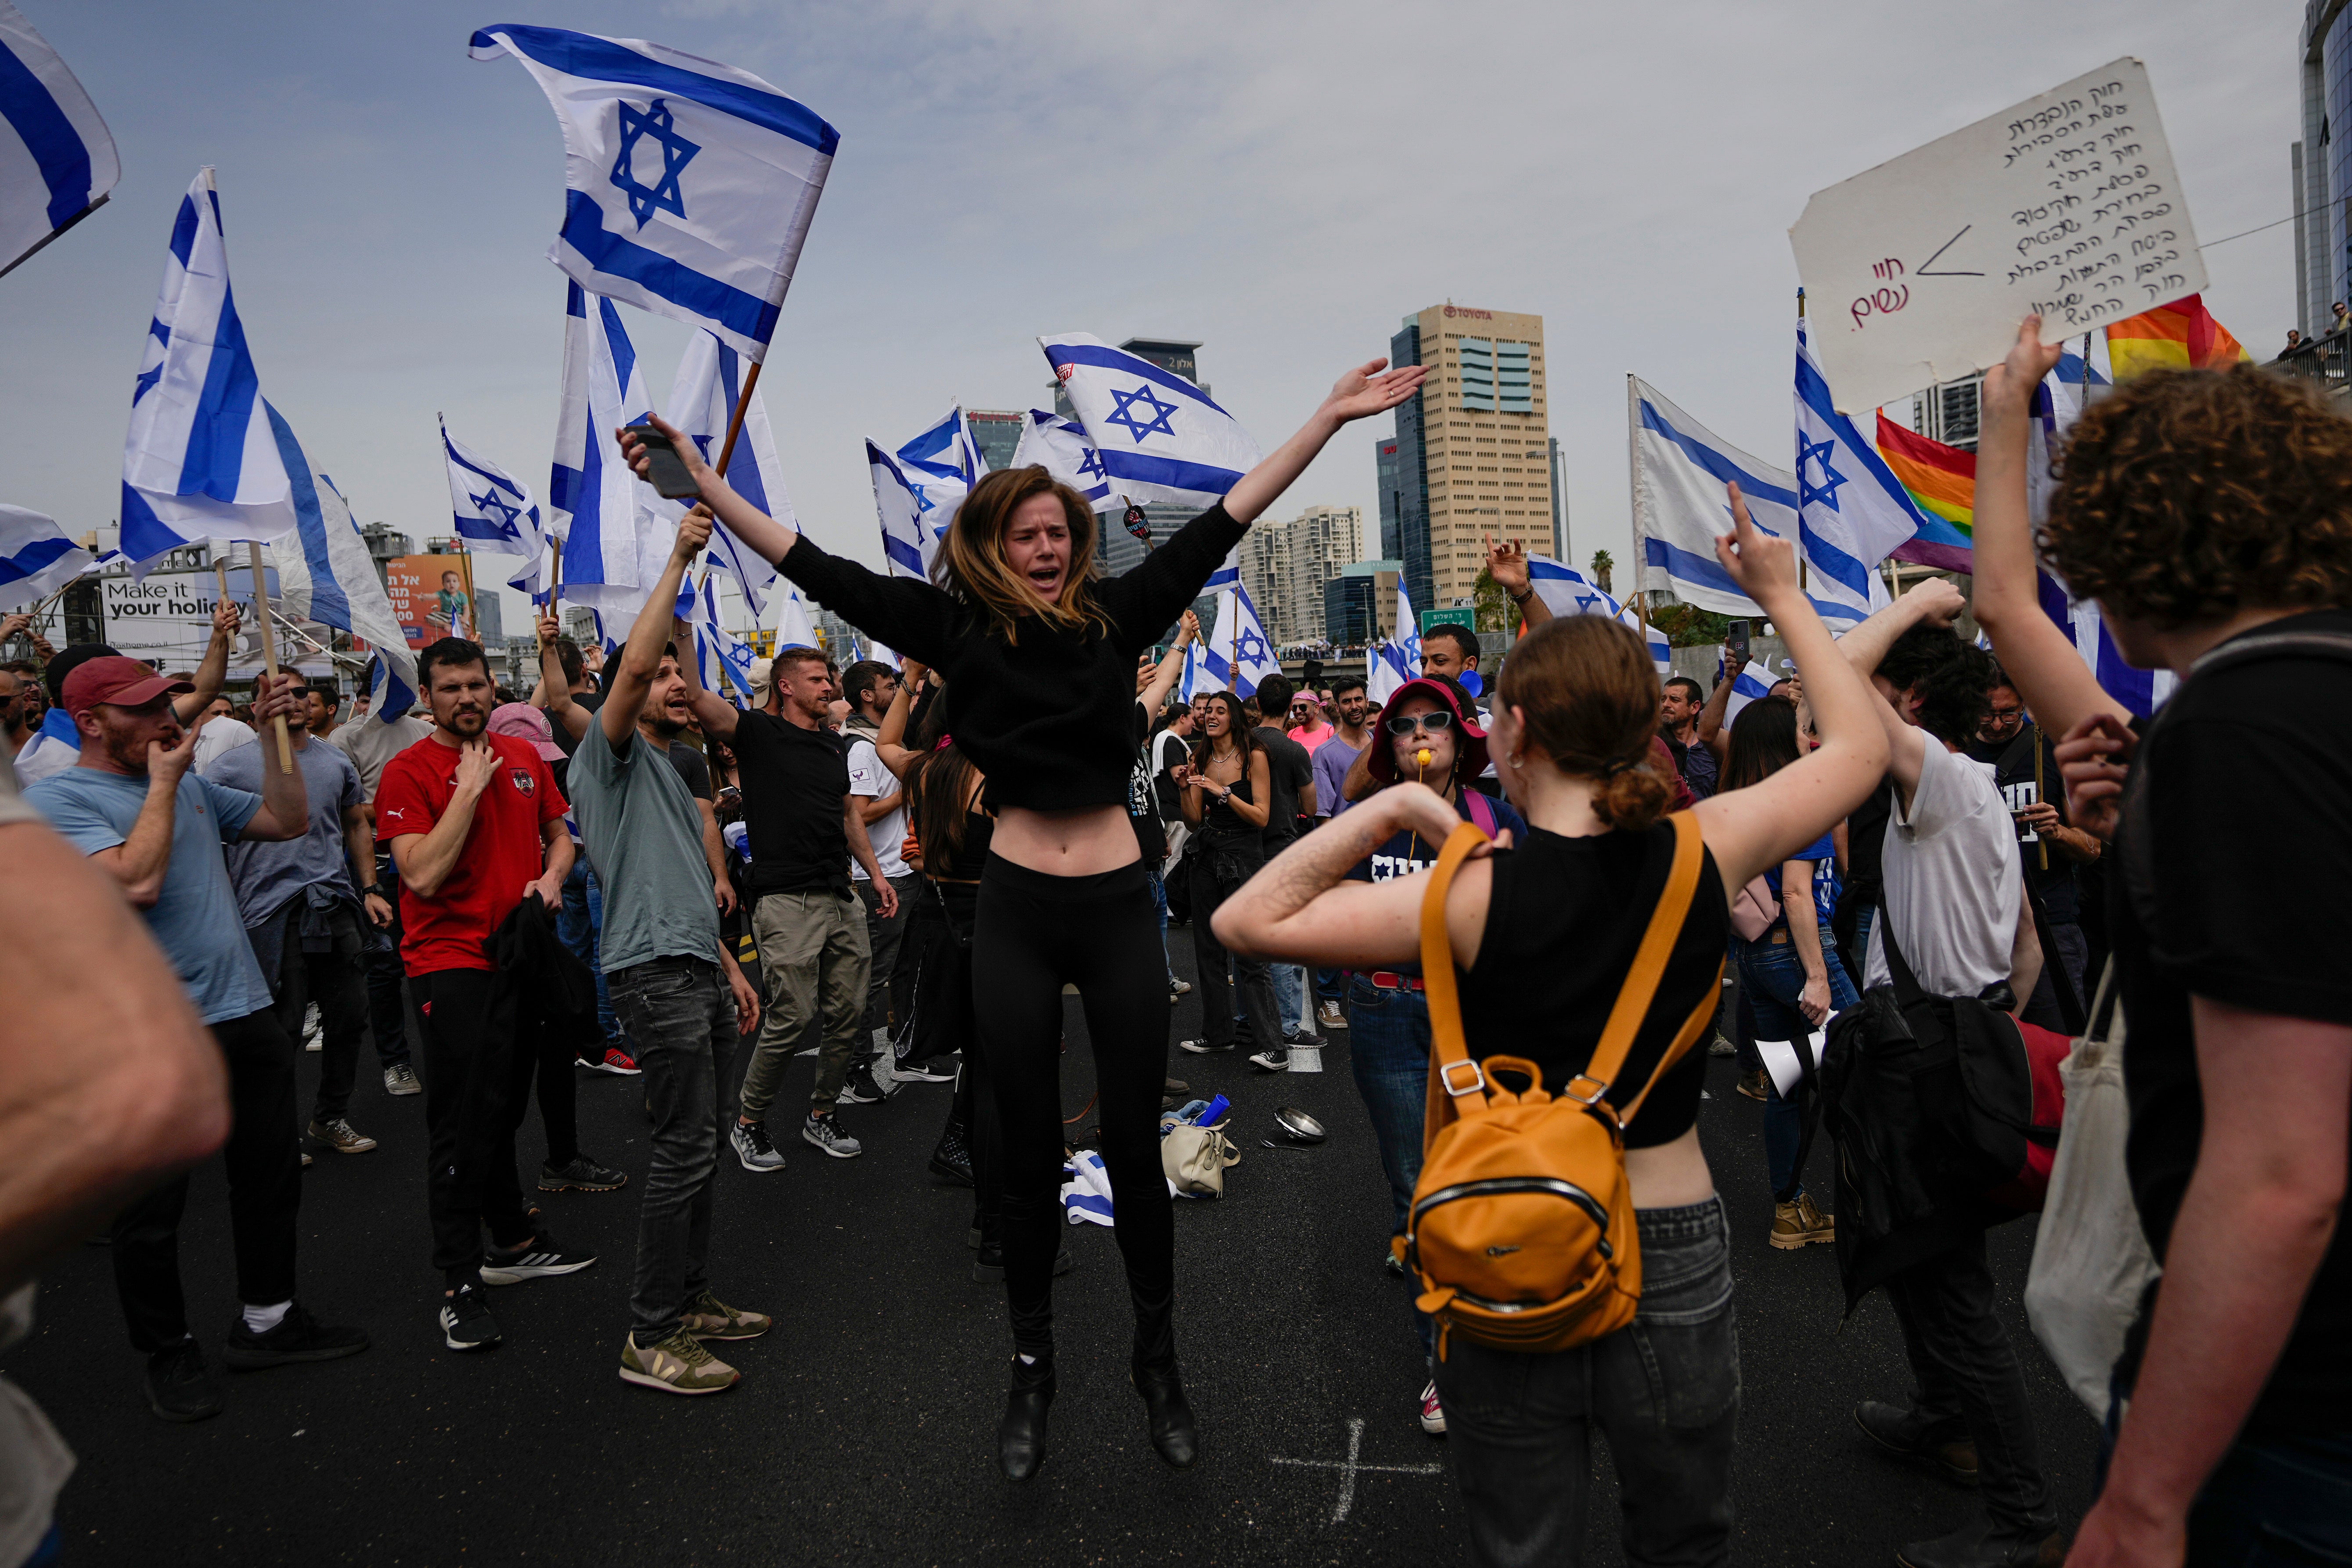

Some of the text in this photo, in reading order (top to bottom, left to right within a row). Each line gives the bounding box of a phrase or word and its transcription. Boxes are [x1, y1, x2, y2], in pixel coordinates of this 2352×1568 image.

[2088, 82, 2123, 107] חוק
[2101, 126, 2134, 147] חוק
[2110, 144, 2142, 166] חוק
[2141, 274, 2186, 302] חוק
[1457, 308, 1492, 320] TOYOTA
[1169, 357, 1175, 368] 2
[1176, 359, 1193, 370] אלון
[1384, 445, 1397, 454] SU
[401, 574, 420, 585] אל
[108, 582, 188, 598] Make it
[388, 588, 409, 598] מה
[110, 598, 247, 620] your holiy
